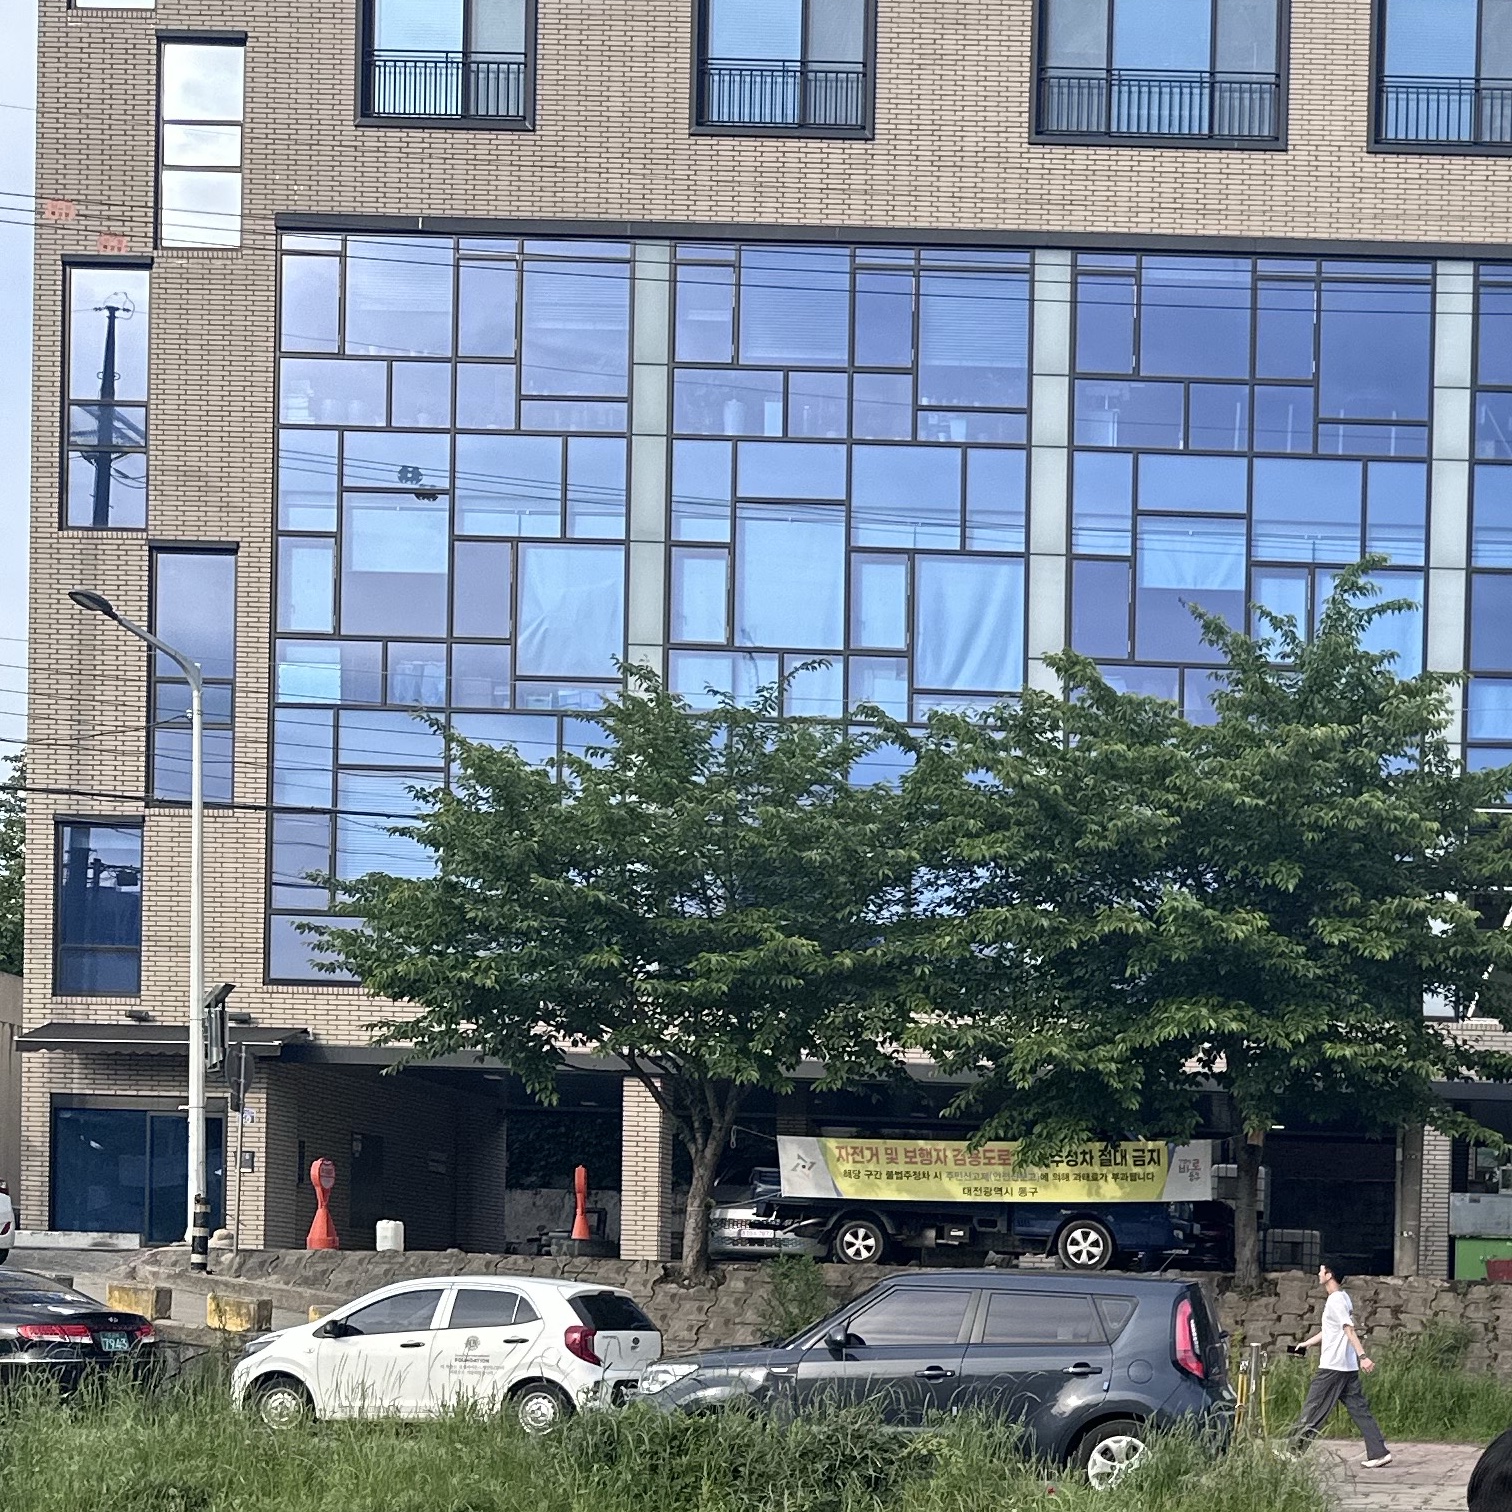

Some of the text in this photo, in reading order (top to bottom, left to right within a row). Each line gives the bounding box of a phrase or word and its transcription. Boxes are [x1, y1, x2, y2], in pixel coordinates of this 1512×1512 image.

[836, 1146, 880, 1164] 자전거
[884, 1147, 899, 1165] 및
[904, 1147, 947, 1166] 보행자
[1098, 1148, 1127, 1167] 절대
[1132, 1149, 1161, 1167] 금지
[843, 1169, 861, 1180] 해당
[864, 1169, 882, 1180] 구간
[886, 1170, 930, 1181] 불법주정차
[933, 1171, 942, 1180] 시
[1052, 1172, 1069, 1182] 의해
[1073, 1172, 1108, 1182] 과태료가
[1111, 1172, 1155, 1182] 부과됩니다
[962, 1186, 1038, 1197] 대전광역시 동구
[103, 1338, 128, 1350] 7943
